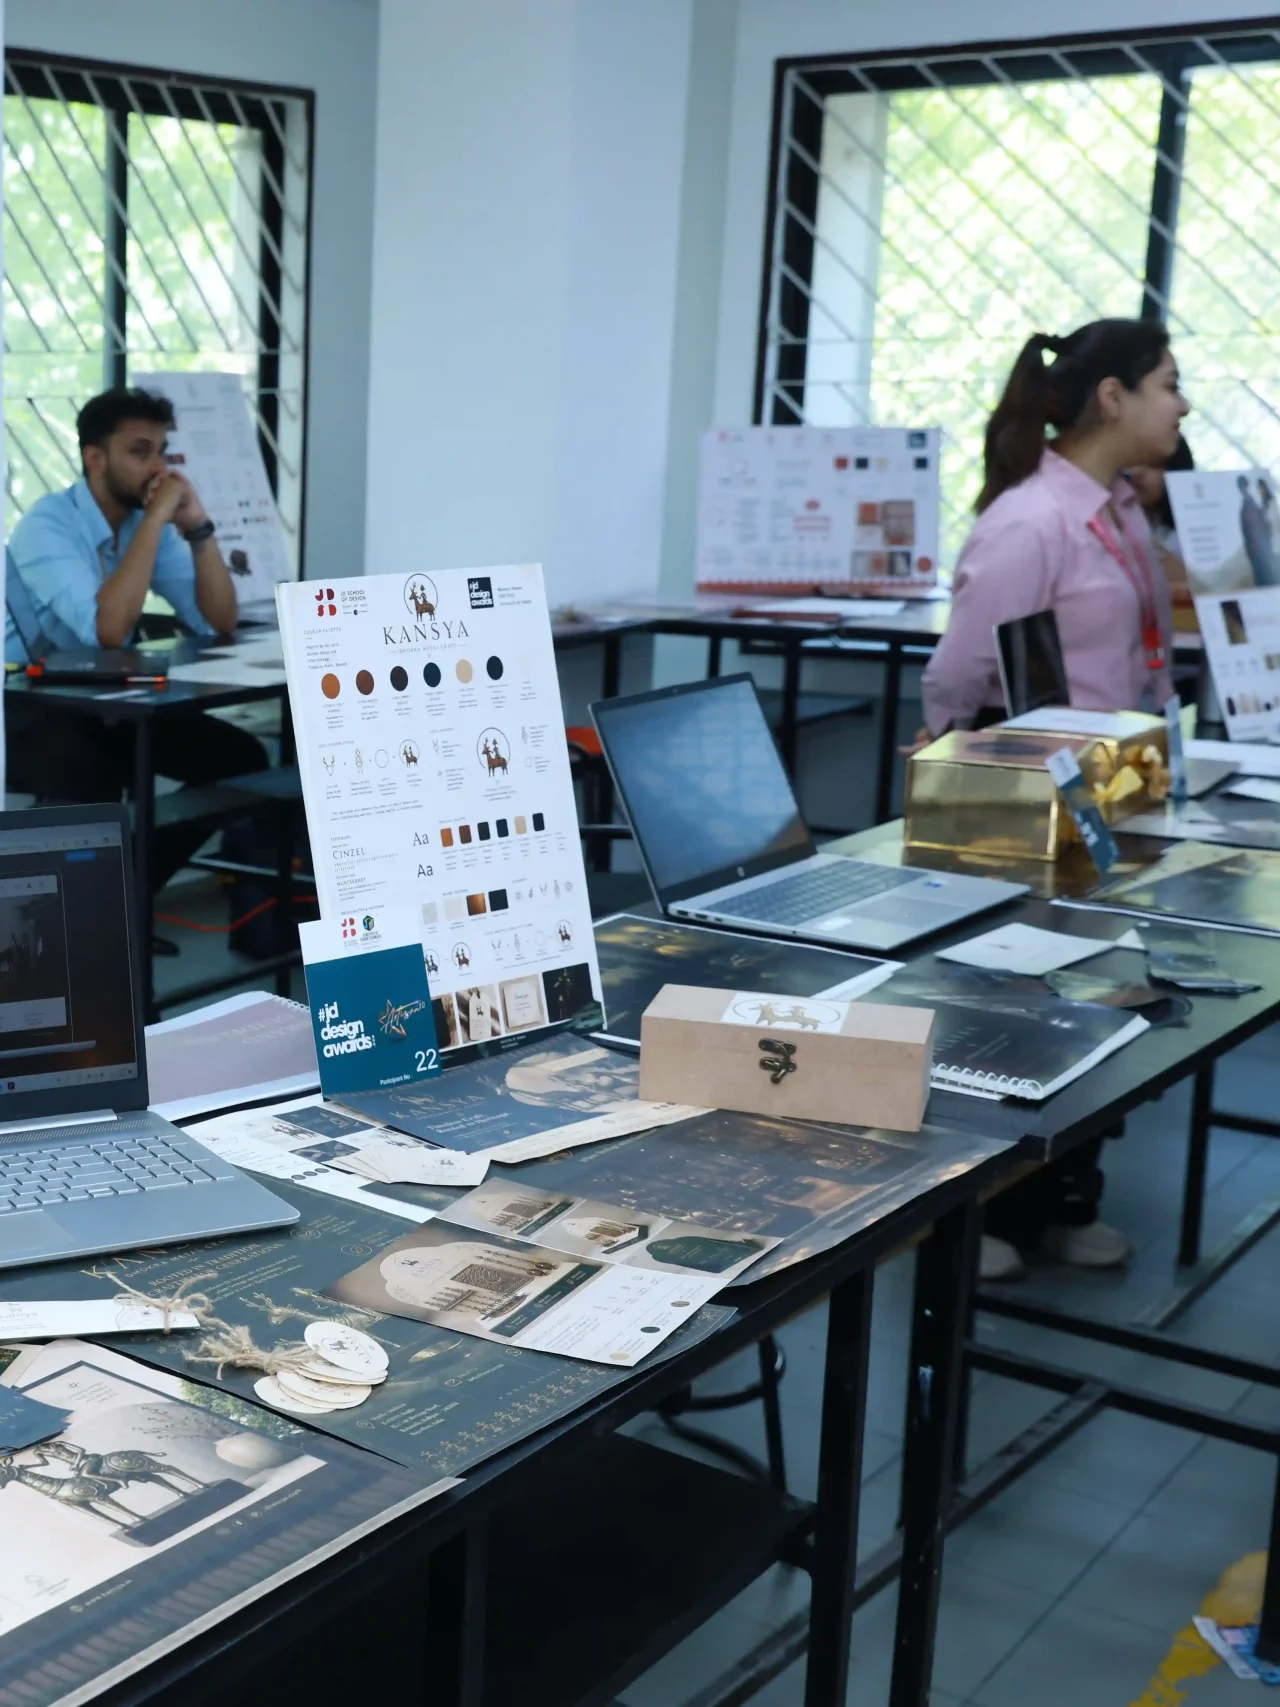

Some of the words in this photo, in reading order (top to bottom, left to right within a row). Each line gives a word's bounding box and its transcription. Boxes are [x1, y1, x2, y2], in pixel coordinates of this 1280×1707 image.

[470, 589, 491, 601] design
[471, 599, 493, 607] awards
[383, 620, 469, 645] KANSYA
[413, 832, 430, 847] Aa
[332, 847, 366, 860] CINZEL
[417, 864, 434, 878] Aa
[318, 1001, 339, 1022] #jd
[321, 1019, 364, 1041] design
[323, 1036, 373, 1058] awards
[414, 1048, 439, 1073] 22
[379, 1075, 403, 1085] Participant
[389, 1095, 485, 1120] KANSYA
[124, 1260, 169, 1278] DHOKRA
[170, 1248, 204, 1262] METAL
[148, 1267, 193, 1287] ROOTED
